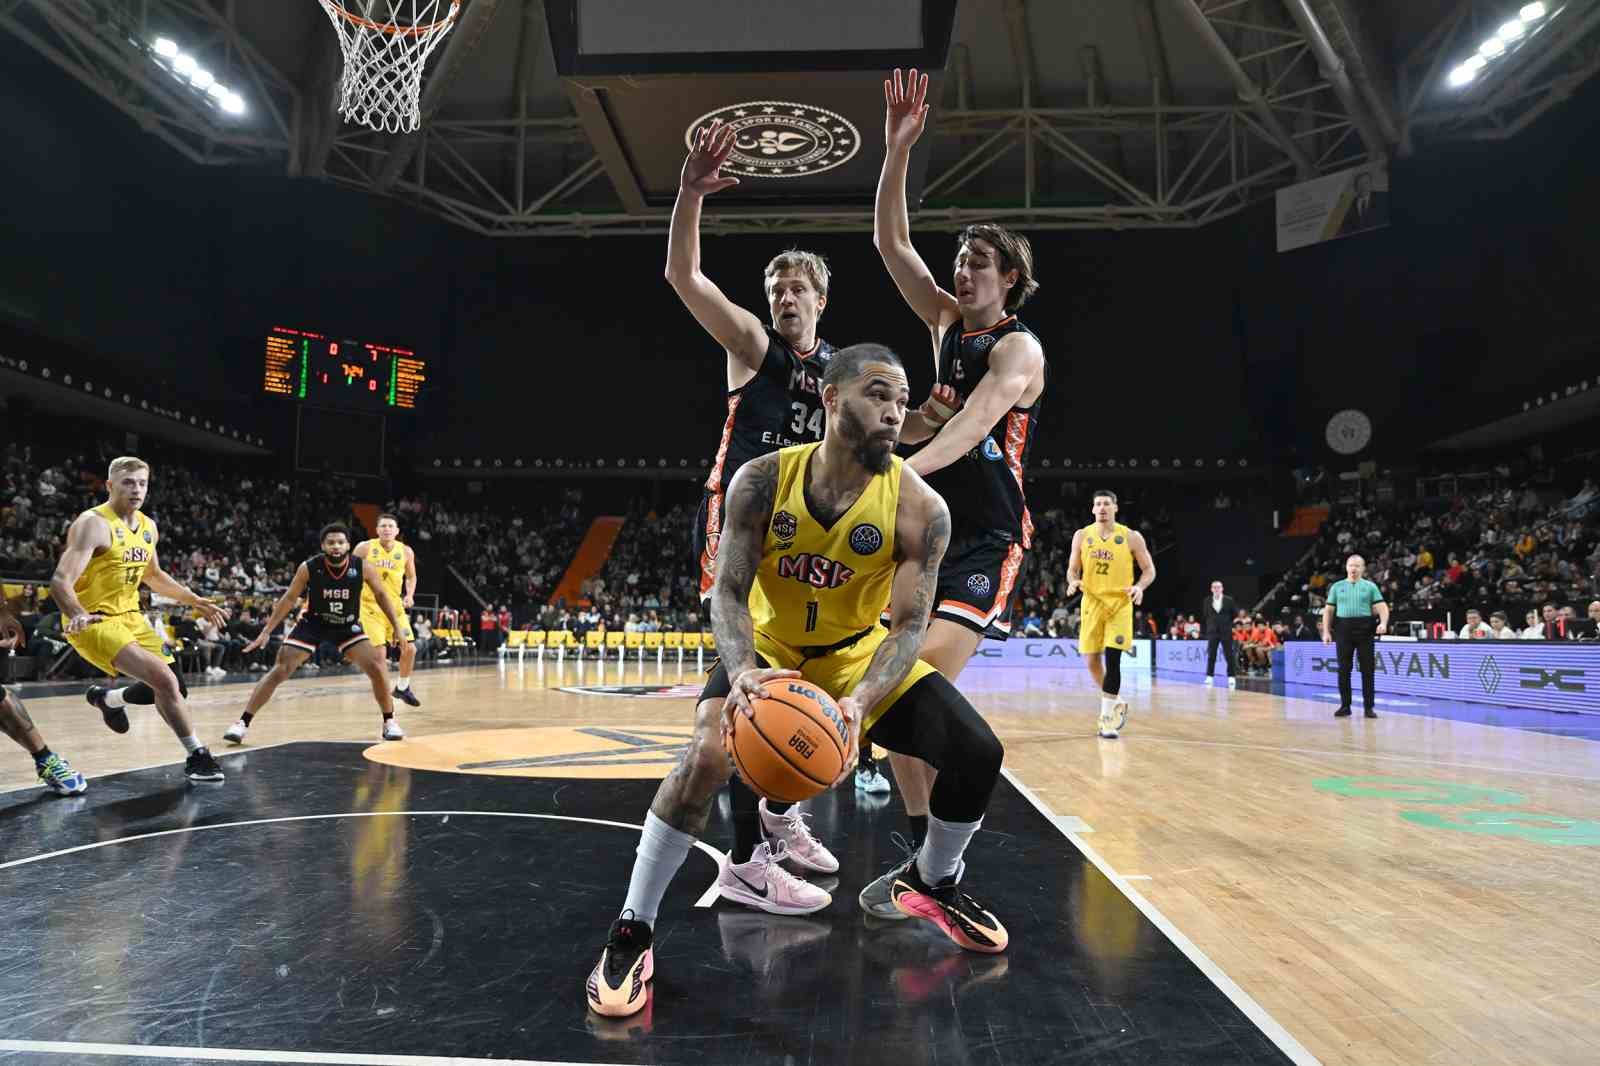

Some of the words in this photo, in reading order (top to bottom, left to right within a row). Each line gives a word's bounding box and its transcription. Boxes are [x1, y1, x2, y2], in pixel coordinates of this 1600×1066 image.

[791, 402, 823, 440] 34
[779, 553, 854, 588] MSK
[1095, 561, 1109, 575] 22
[323, 588, 350, 600] MSB
[329, 601, 344, 614] 12
[805, 601, 818, 632] 1
[1025, 643, 1137, 659] CAYN
[1356, 651, 1450, 679] AYAN
[788, 734, 814, 759] FIBA
